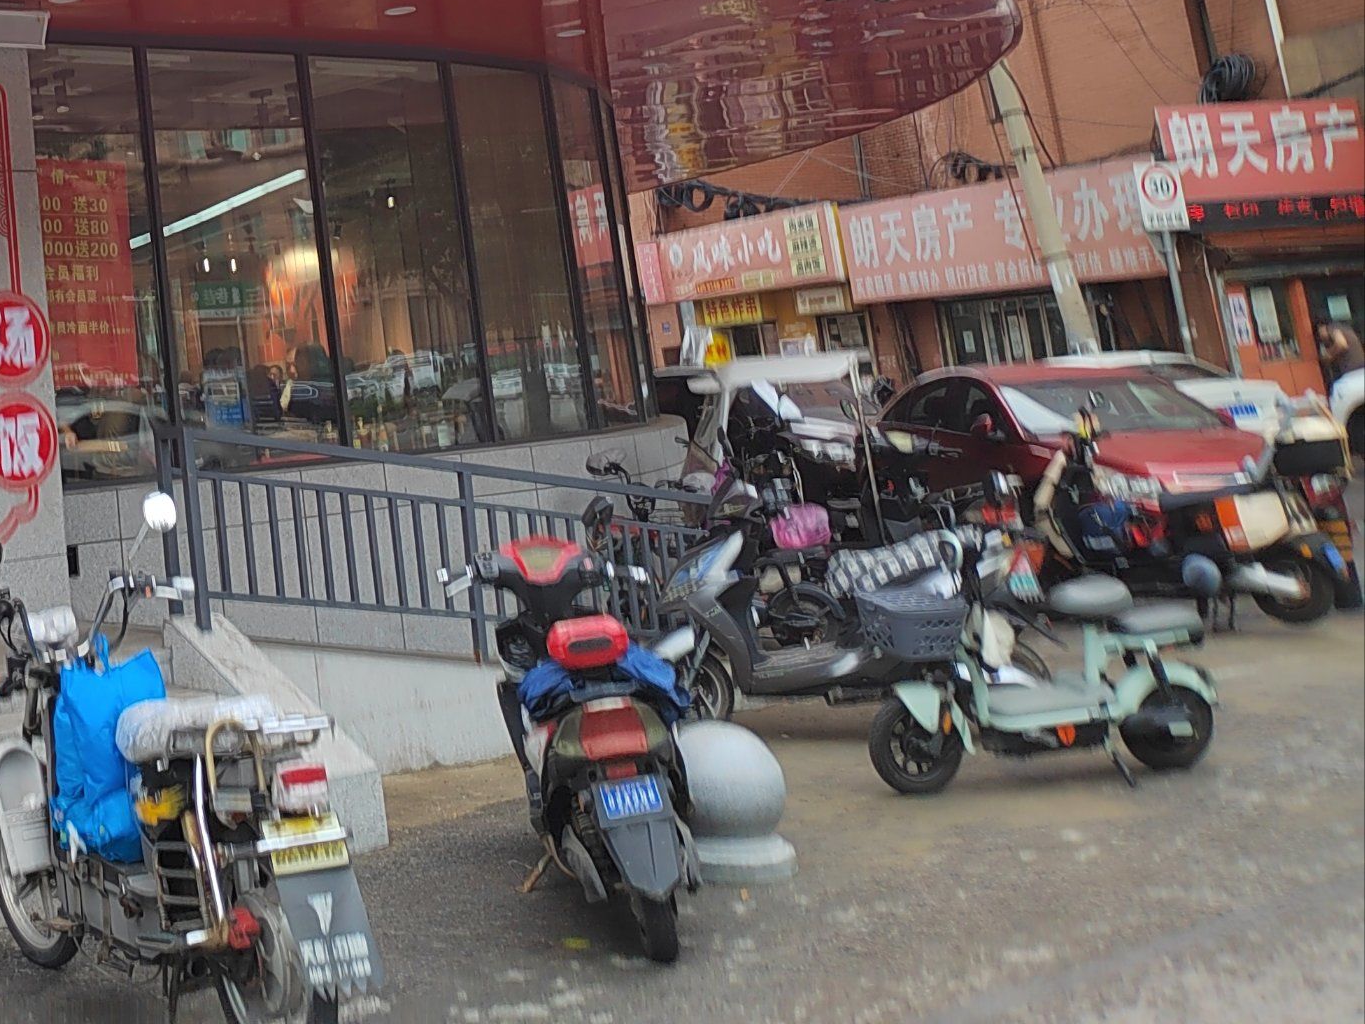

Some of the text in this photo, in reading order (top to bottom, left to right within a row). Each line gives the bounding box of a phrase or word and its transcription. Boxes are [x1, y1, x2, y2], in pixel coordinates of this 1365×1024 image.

[1168, 103, 1359, 178] 朗天房产
[692, 227, 782, 274] 风味小吃
[849, 172, 1146, 268] 朗天房产 专办理
